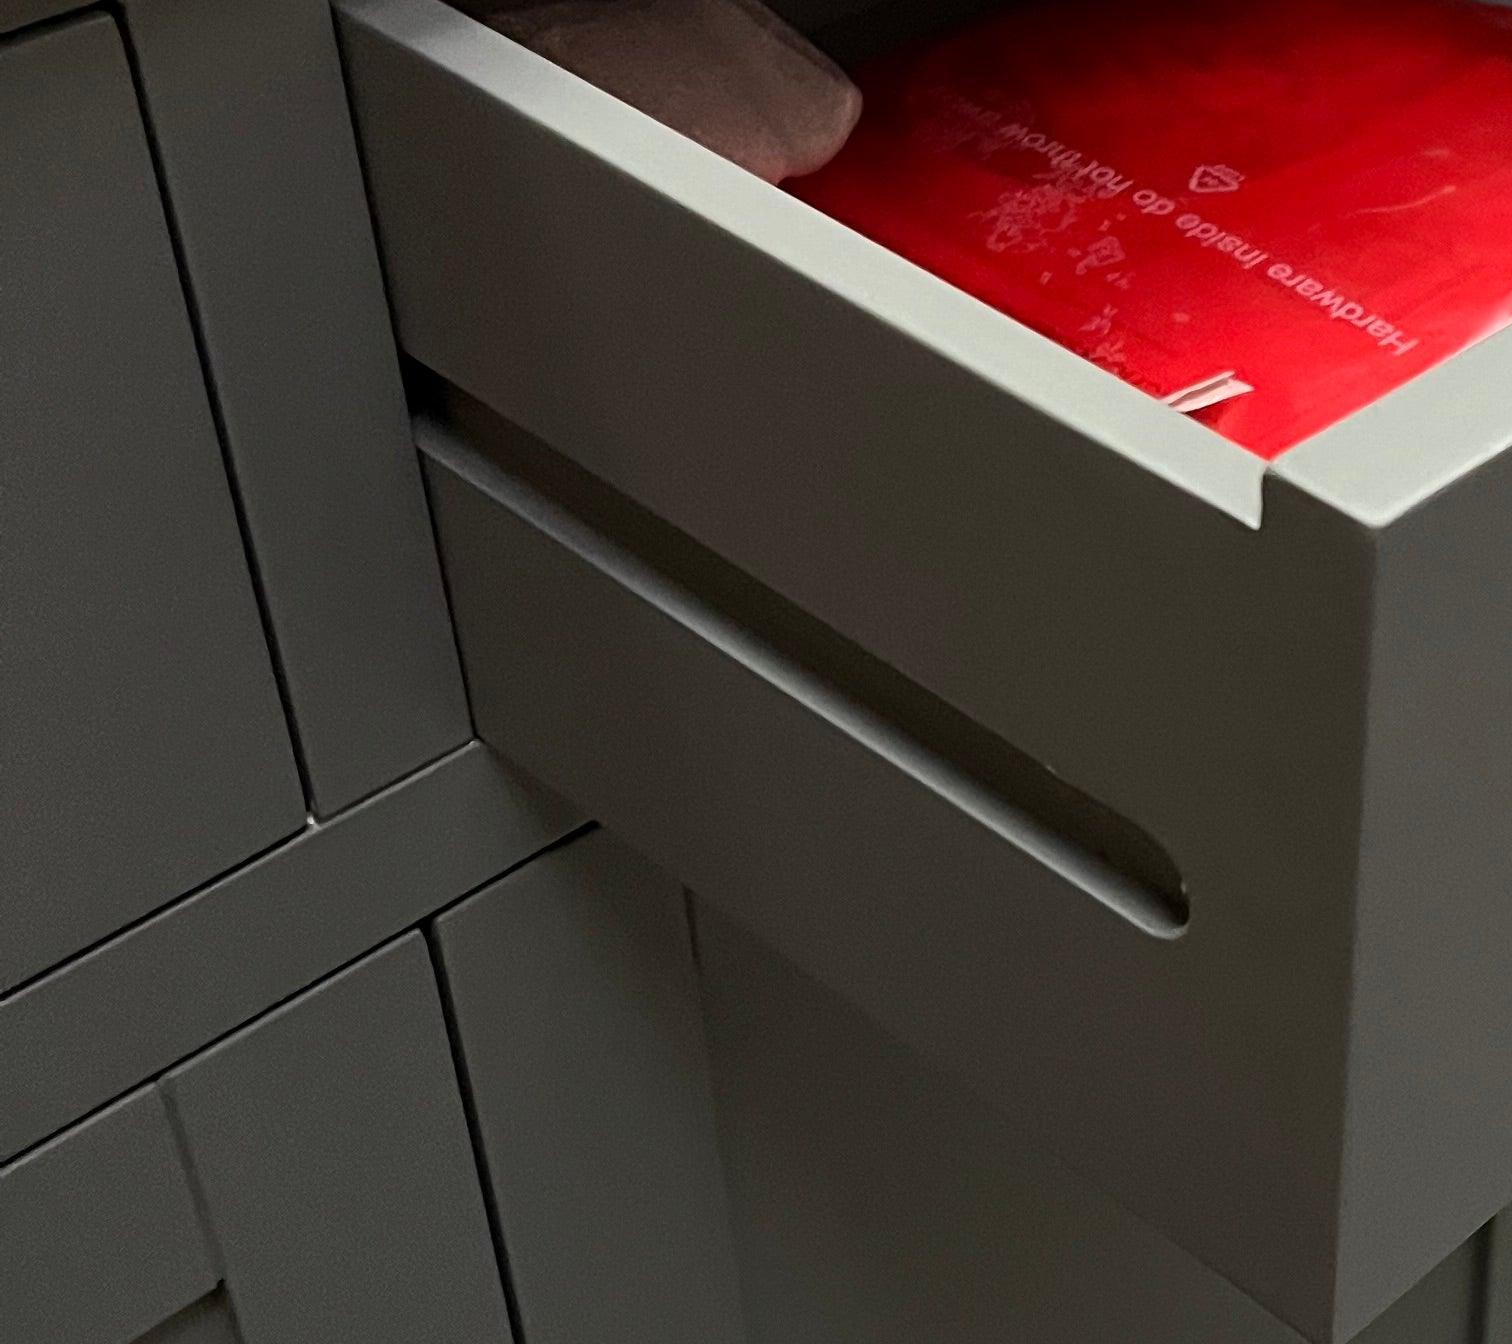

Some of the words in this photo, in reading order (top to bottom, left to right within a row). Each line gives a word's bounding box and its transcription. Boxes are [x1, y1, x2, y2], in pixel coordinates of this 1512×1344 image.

[1077, 160, 1133, 197] not
[1133, 188, 1174, 216] do
[1267, 262, 1418, 355] Hardware
